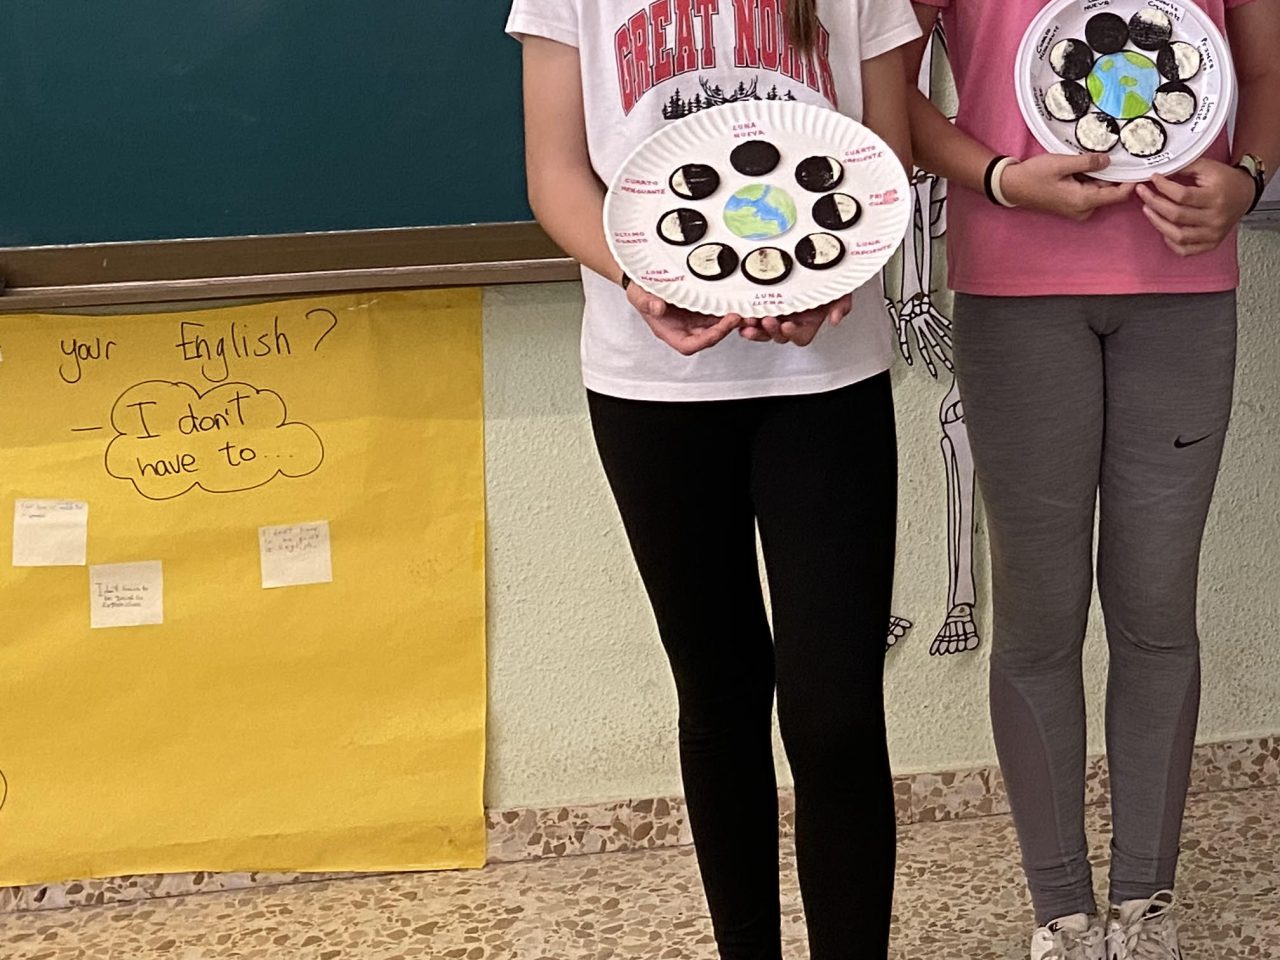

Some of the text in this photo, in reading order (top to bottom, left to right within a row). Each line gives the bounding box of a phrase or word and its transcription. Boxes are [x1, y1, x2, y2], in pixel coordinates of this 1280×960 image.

[732, 122, 757, 131] LUNA
[60, 336, 117, 383] your
[126, 391, 251, 439] I don't
[136, 451, 198, 480] have
